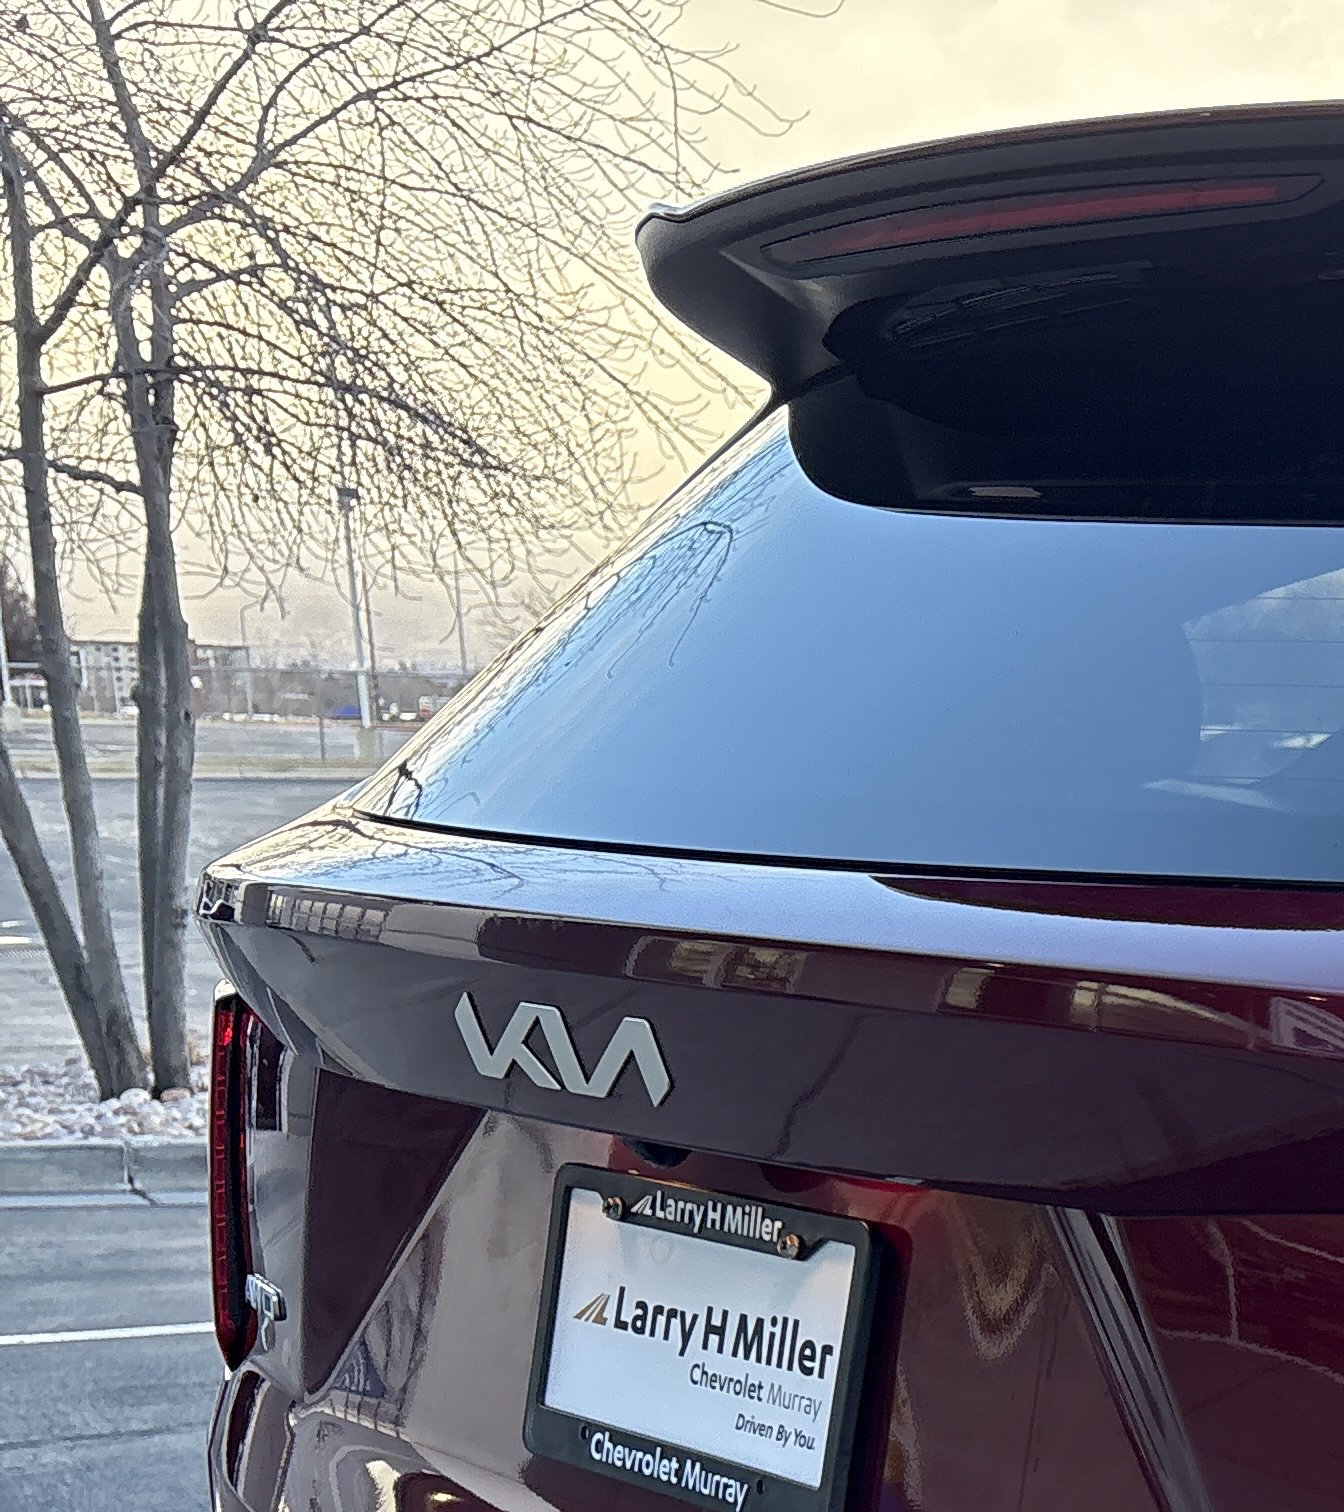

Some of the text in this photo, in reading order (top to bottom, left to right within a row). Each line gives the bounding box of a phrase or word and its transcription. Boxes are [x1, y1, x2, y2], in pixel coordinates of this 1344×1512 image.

[454, 991, 673, 1108] KIA
[655, 1190, 783, 1243] Larry H Miller
[613, 1285, 835, 1380] Larry H Miller
[689, 1363, 823, 1422] Chevrolet Murray
[734, 1413, 774, 1440] Driven
[775, 1419, 793, 1449] By
[590, 1430, 750, 1512] Chevrolet Murray
